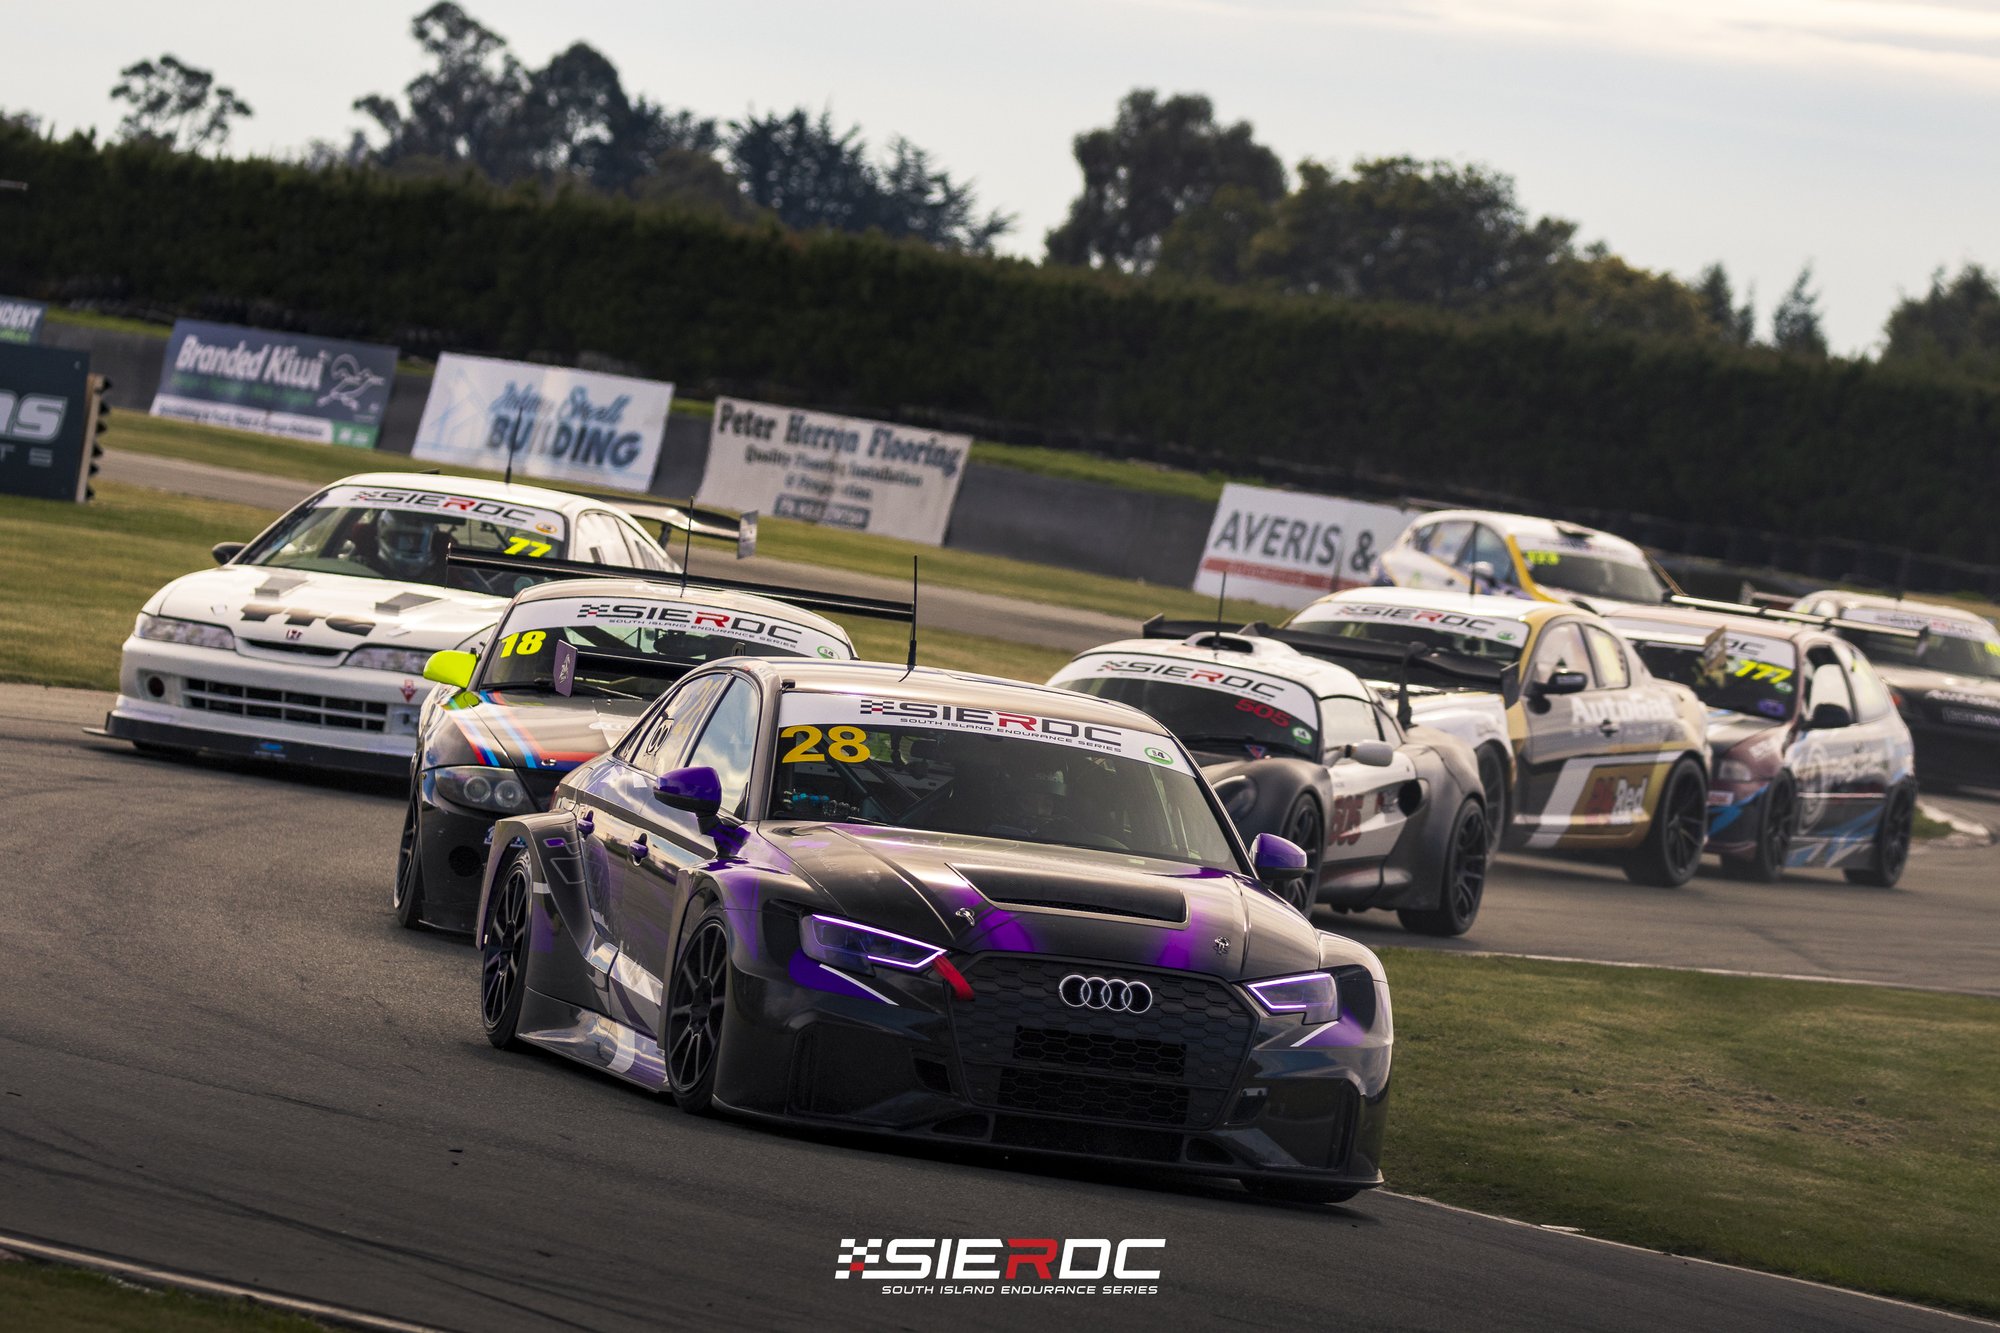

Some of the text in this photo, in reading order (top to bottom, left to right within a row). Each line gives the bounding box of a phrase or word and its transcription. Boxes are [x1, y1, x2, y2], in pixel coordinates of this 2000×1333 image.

[175, 334, 270, 380] Branded
[263, 345, 324, 390] Kiwi
[719, 402, 777, 439] Peter
[867, 427, 962, 478] Flooring
[365, 491, 535, 523] SIERDC
[504, 536, 552, 558] 77
[1214, 510, 1342, 566] AVERIS
[600, 604, 803, 644] SIERDC
[649, 620, 687, 629] ISLAND
[690, 625, 756, 639] ENDURANCE
[1354, 606, 1496, 632] SIERDC
[500, 630, 547, 659] 18
[1114, 661, 1285, 700] SIERDC
[1734, 659, 1793, 684] 777
[895, 701, 1122, 748] SIERDC
[1234, 698, 1293, 728] 505
[780, 725, 871, 764] 28
[900, 717, 1122, 753] SOUTH ISLAND ENDURANCE SERIES
